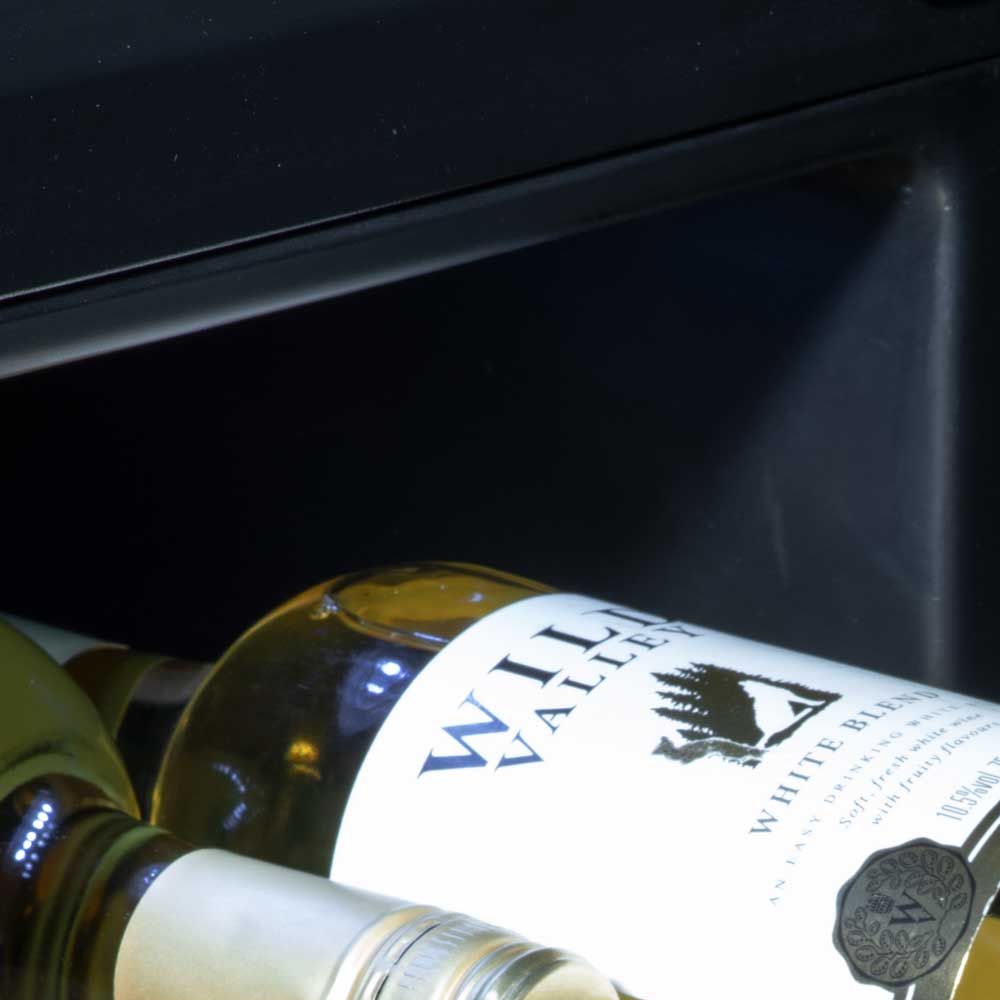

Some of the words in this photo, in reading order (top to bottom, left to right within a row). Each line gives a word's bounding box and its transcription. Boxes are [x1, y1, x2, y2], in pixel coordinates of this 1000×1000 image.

[494, 623, 705, 772] VALLEY
[749, 735, 845, 835] WHITE
[839, 690, 939, 732] BLEND
[823, 731, 904, 804] DRINKING
[870, 753, 909, 791] fresh
[909, 727, 948, 752] white
[870, 791, 902, 827] with
[898, 753, 943, 794] fruity
